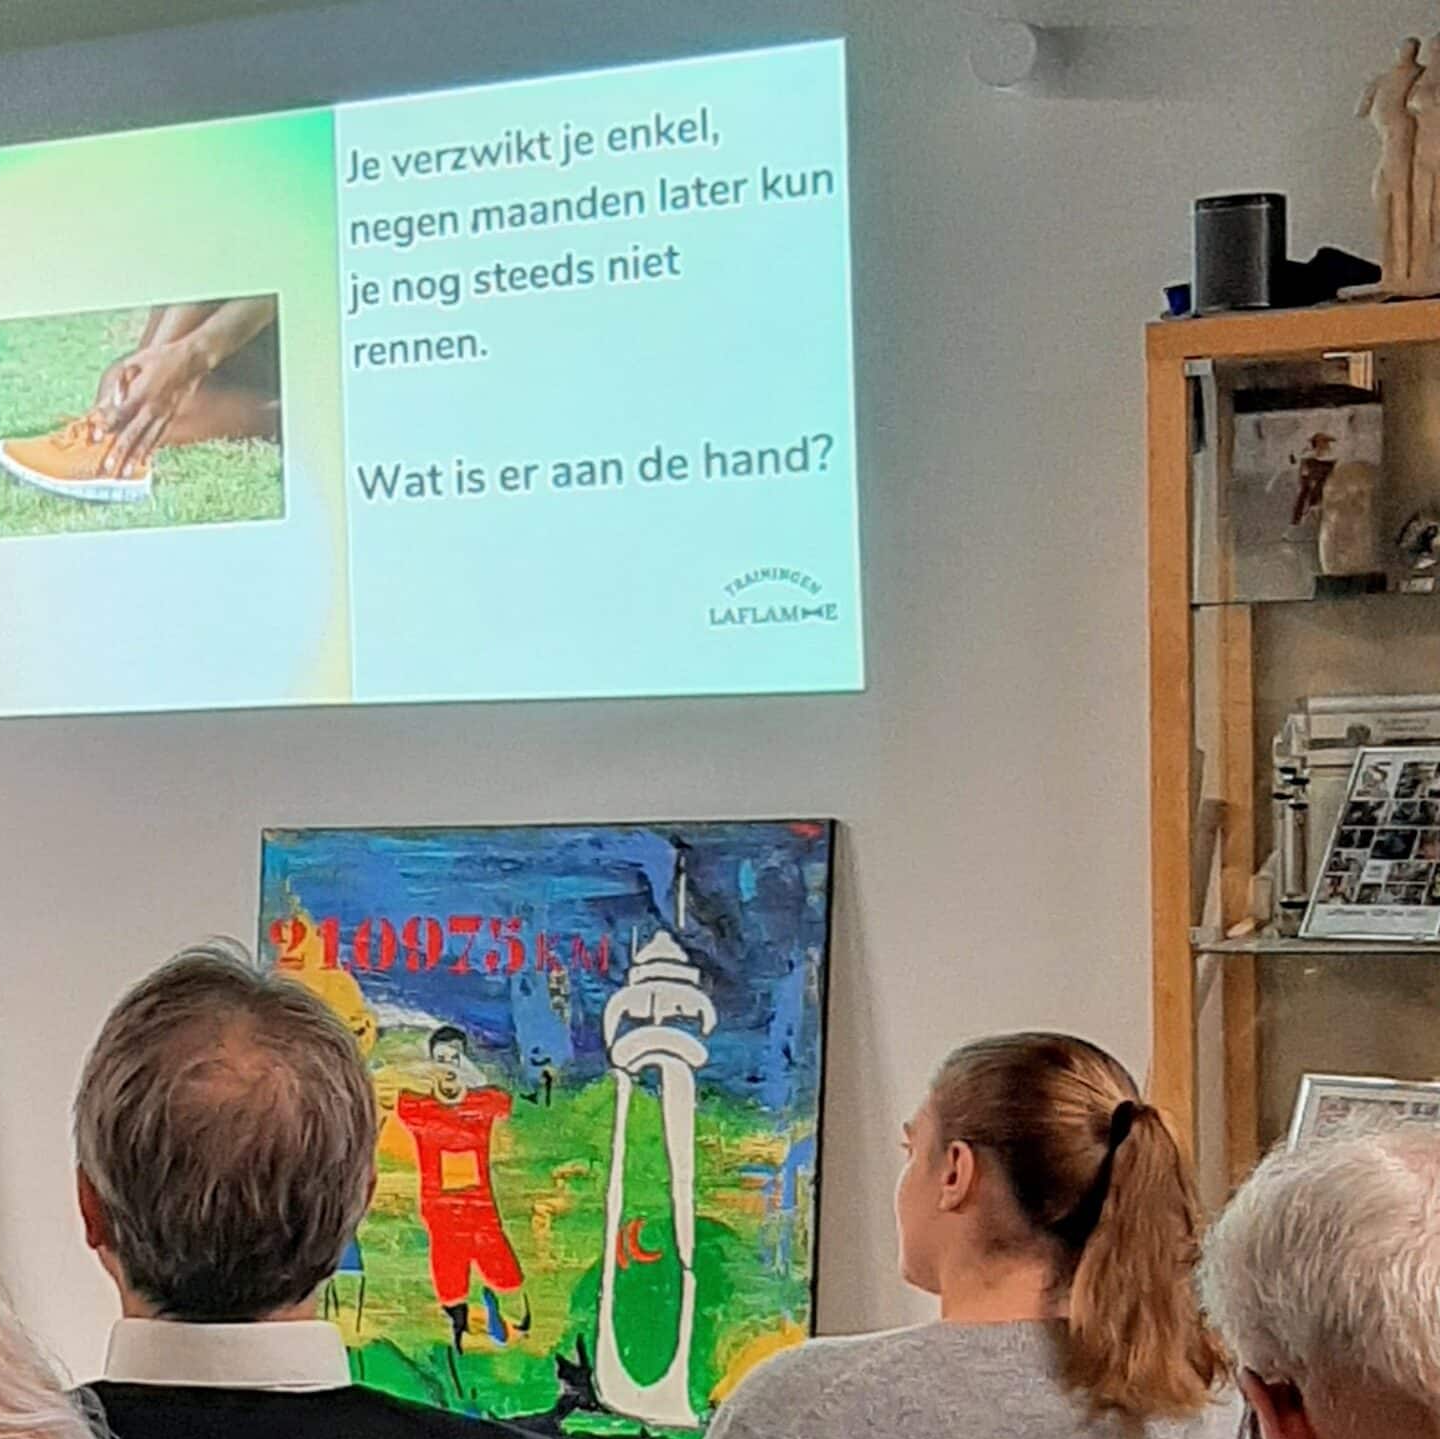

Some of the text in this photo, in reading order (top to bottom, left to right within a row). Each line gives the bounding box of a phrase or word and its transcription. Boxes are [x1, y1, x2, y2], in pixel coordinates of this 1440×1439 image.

[346, 105, 720, 184] Je verzwikt je enkel,
[349, 165, 835, 248] negen maanden later kun
[346, 244, 681, 315] je nog steeds niet
[352, 333, 489, 369] rennen.
[356, 432, 835, 501] Wat is er aan de hand?
[723, 566, 823, 598] TRAININGEN
